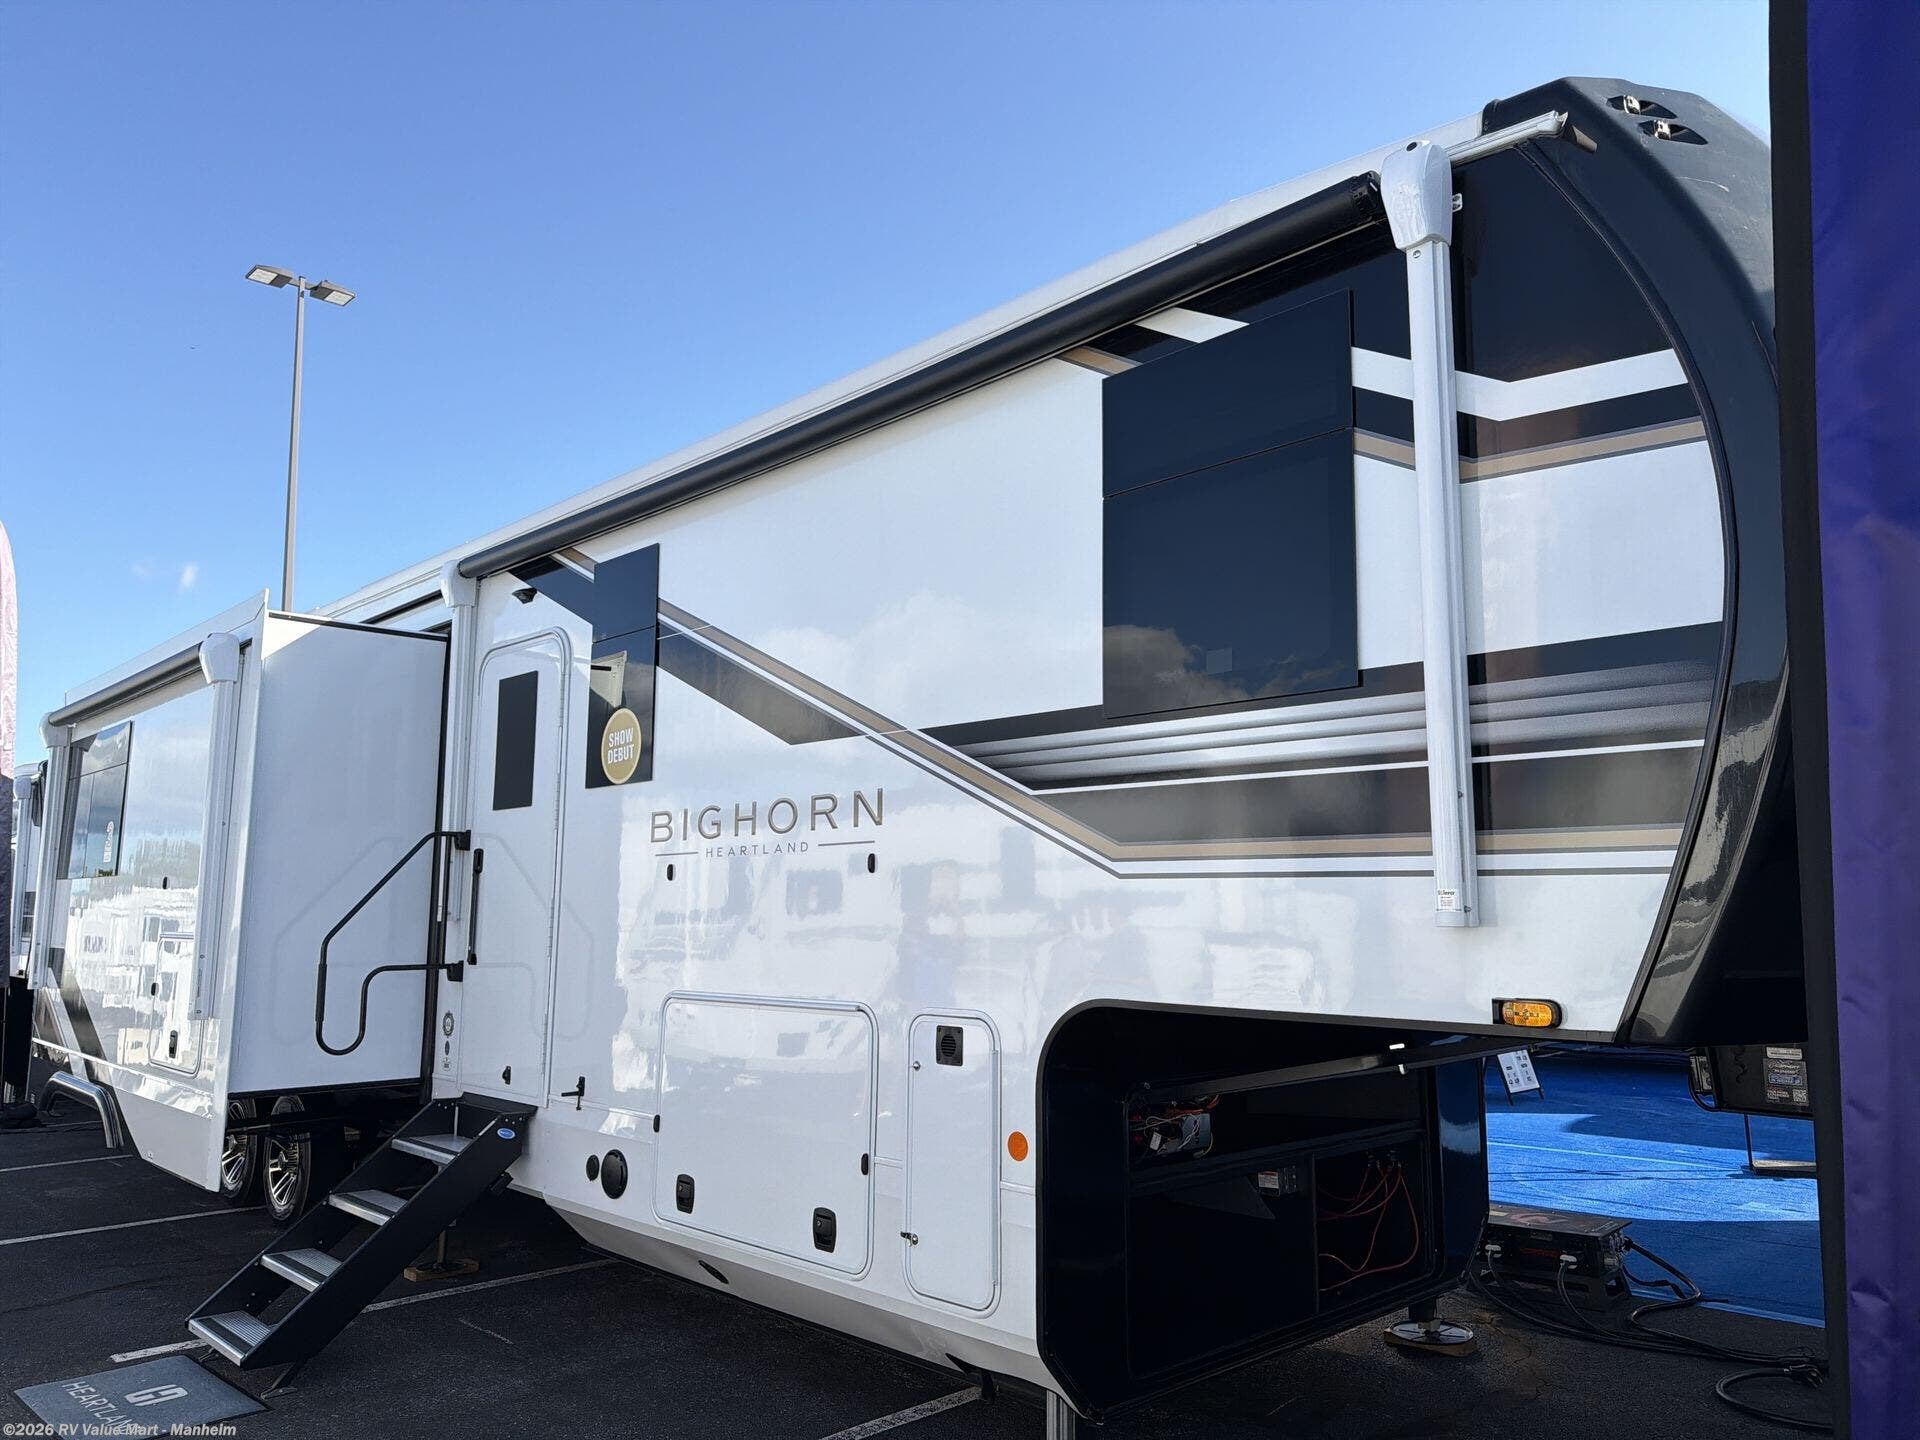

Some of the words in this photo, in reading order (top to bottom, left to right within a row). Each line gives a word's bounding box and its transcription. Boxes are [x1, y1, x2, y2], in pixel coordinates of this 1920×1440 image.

[608, 727, 634, 748] SHOW
[607, 743, 635, 765] DEBUT
[650, 788, 884, 843] BIGHORN
[705, 841, 809, 858] HEARTLAND
